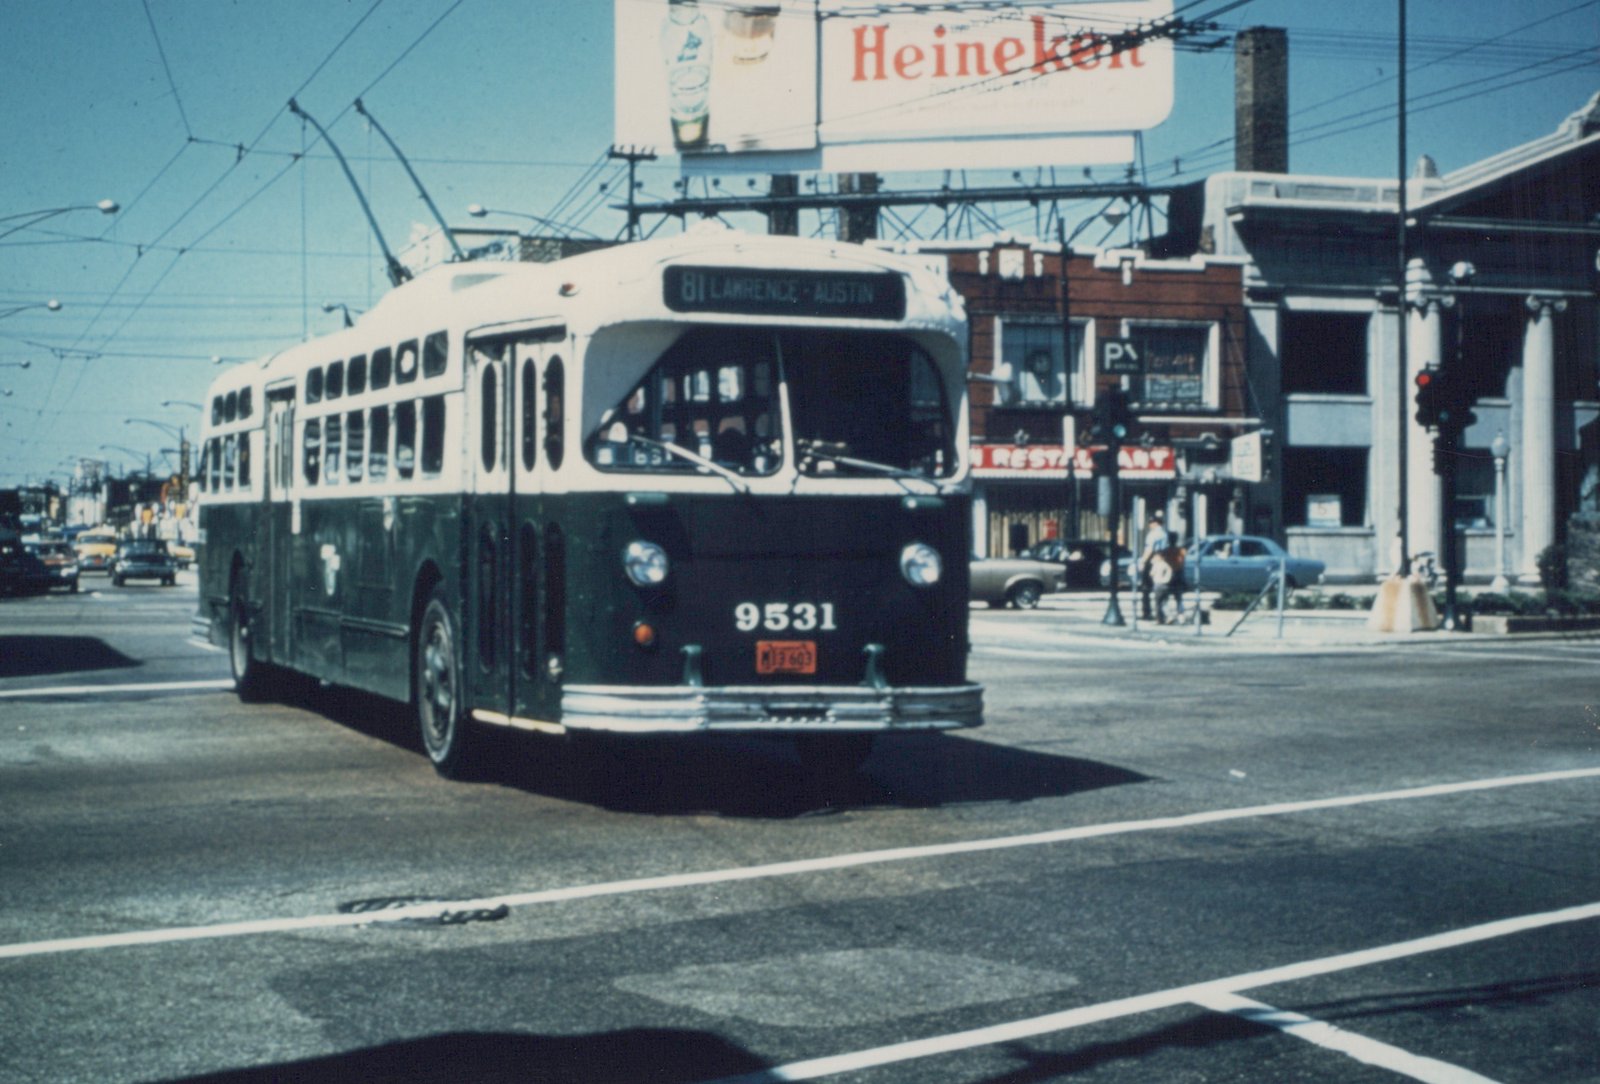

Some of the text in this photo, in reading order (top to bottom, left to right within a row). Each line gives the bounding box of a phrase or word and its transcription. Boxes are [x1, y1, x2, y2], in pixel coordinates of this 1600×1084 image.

[852, 15, 1147, 82] Heineken
[682, 271, 705, 302] 81
[710, 277, 799, 301] LAWRENCE
[814, 280, 875, 304] AUSTIN
[993, 447, 1169, 469] RESTAUANT
[734, 601, 837, 631] 9531
